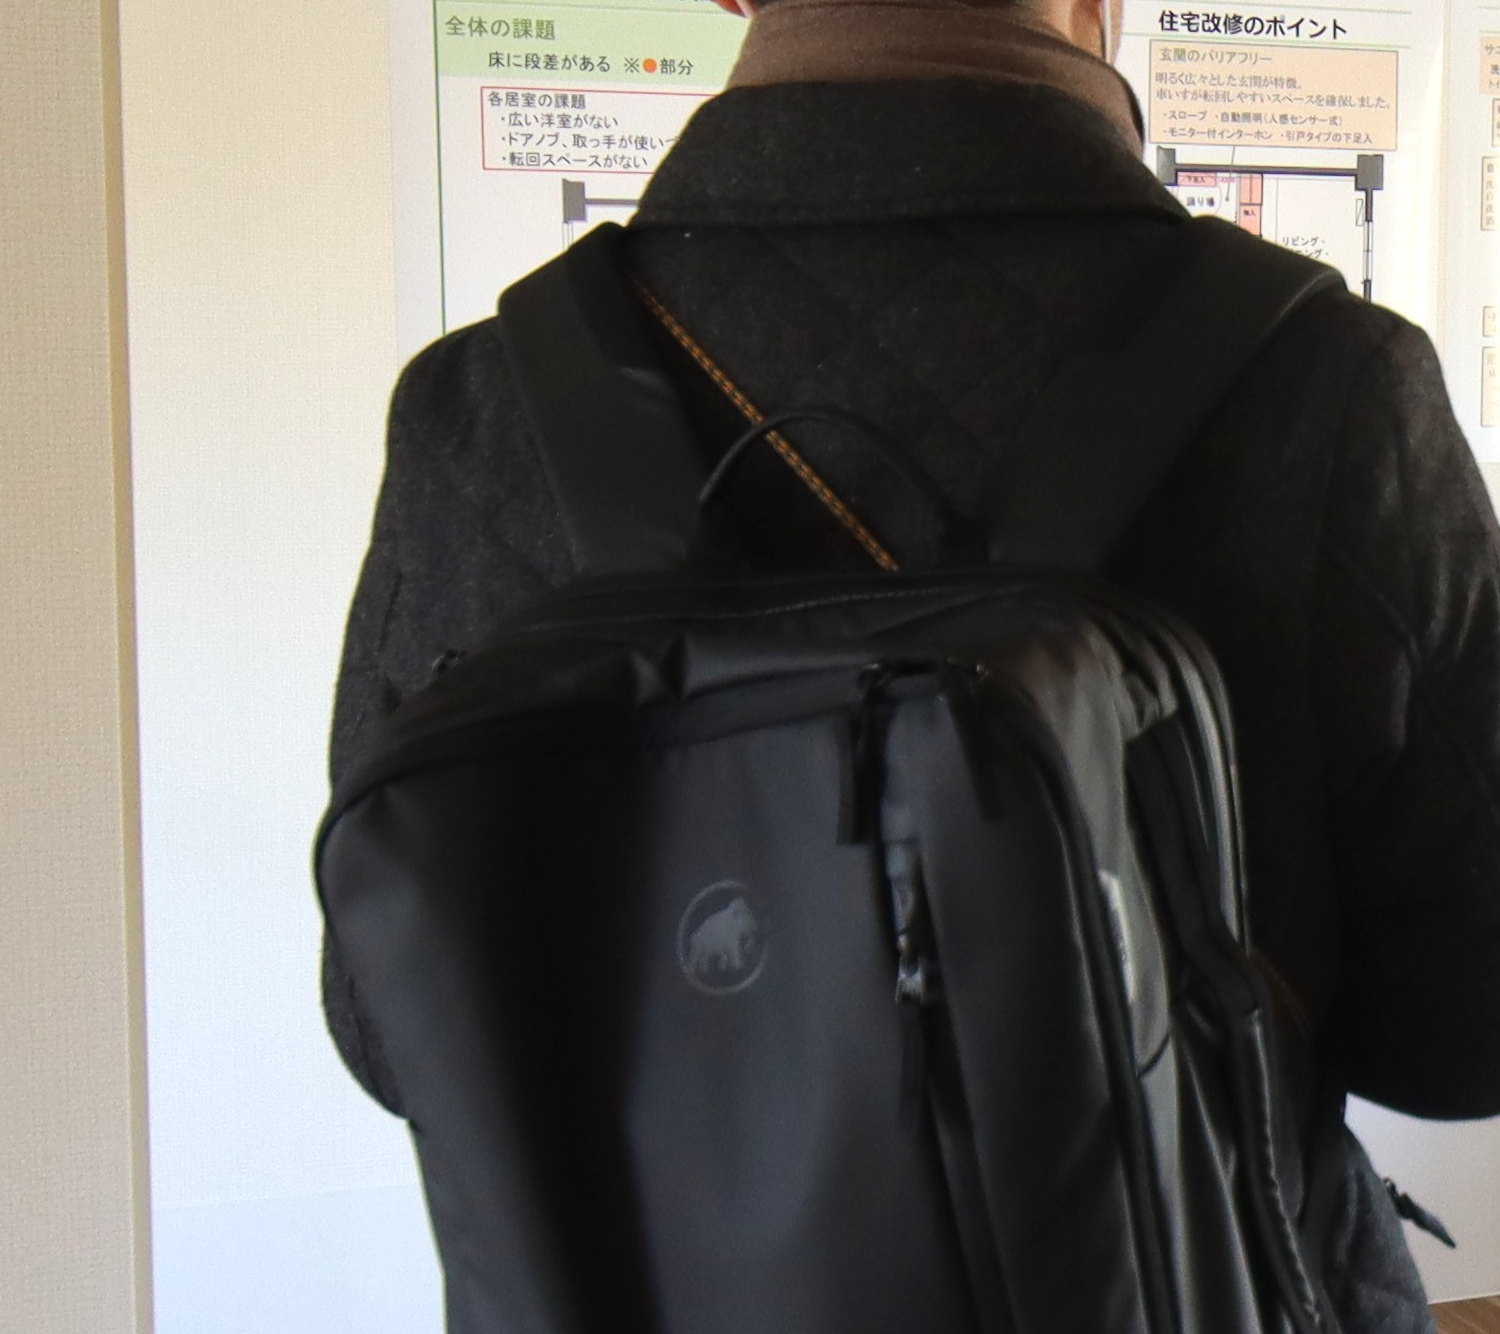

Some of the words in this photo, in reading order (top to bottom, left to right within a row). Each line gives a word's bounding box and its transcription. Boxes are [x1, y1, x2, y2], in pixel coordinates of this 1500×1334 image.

[444, 15, 557, 42] 全体の課題
[1158, 10, 1347, 40] 住宅改修のポイント
[488, 50, 611, 73] 床に段差がある
[1159, 47, 1273, 65] 玄関のバリアフリー
[1155, 71, 1302, 90] 明るく広々とした玄関が特徴。
[488, 91, 586, 110] 各居室の課題
[501, 112, 619, 130] ・広い洋室がない
[501, 151, 648, 169] ・転回スペースがない
